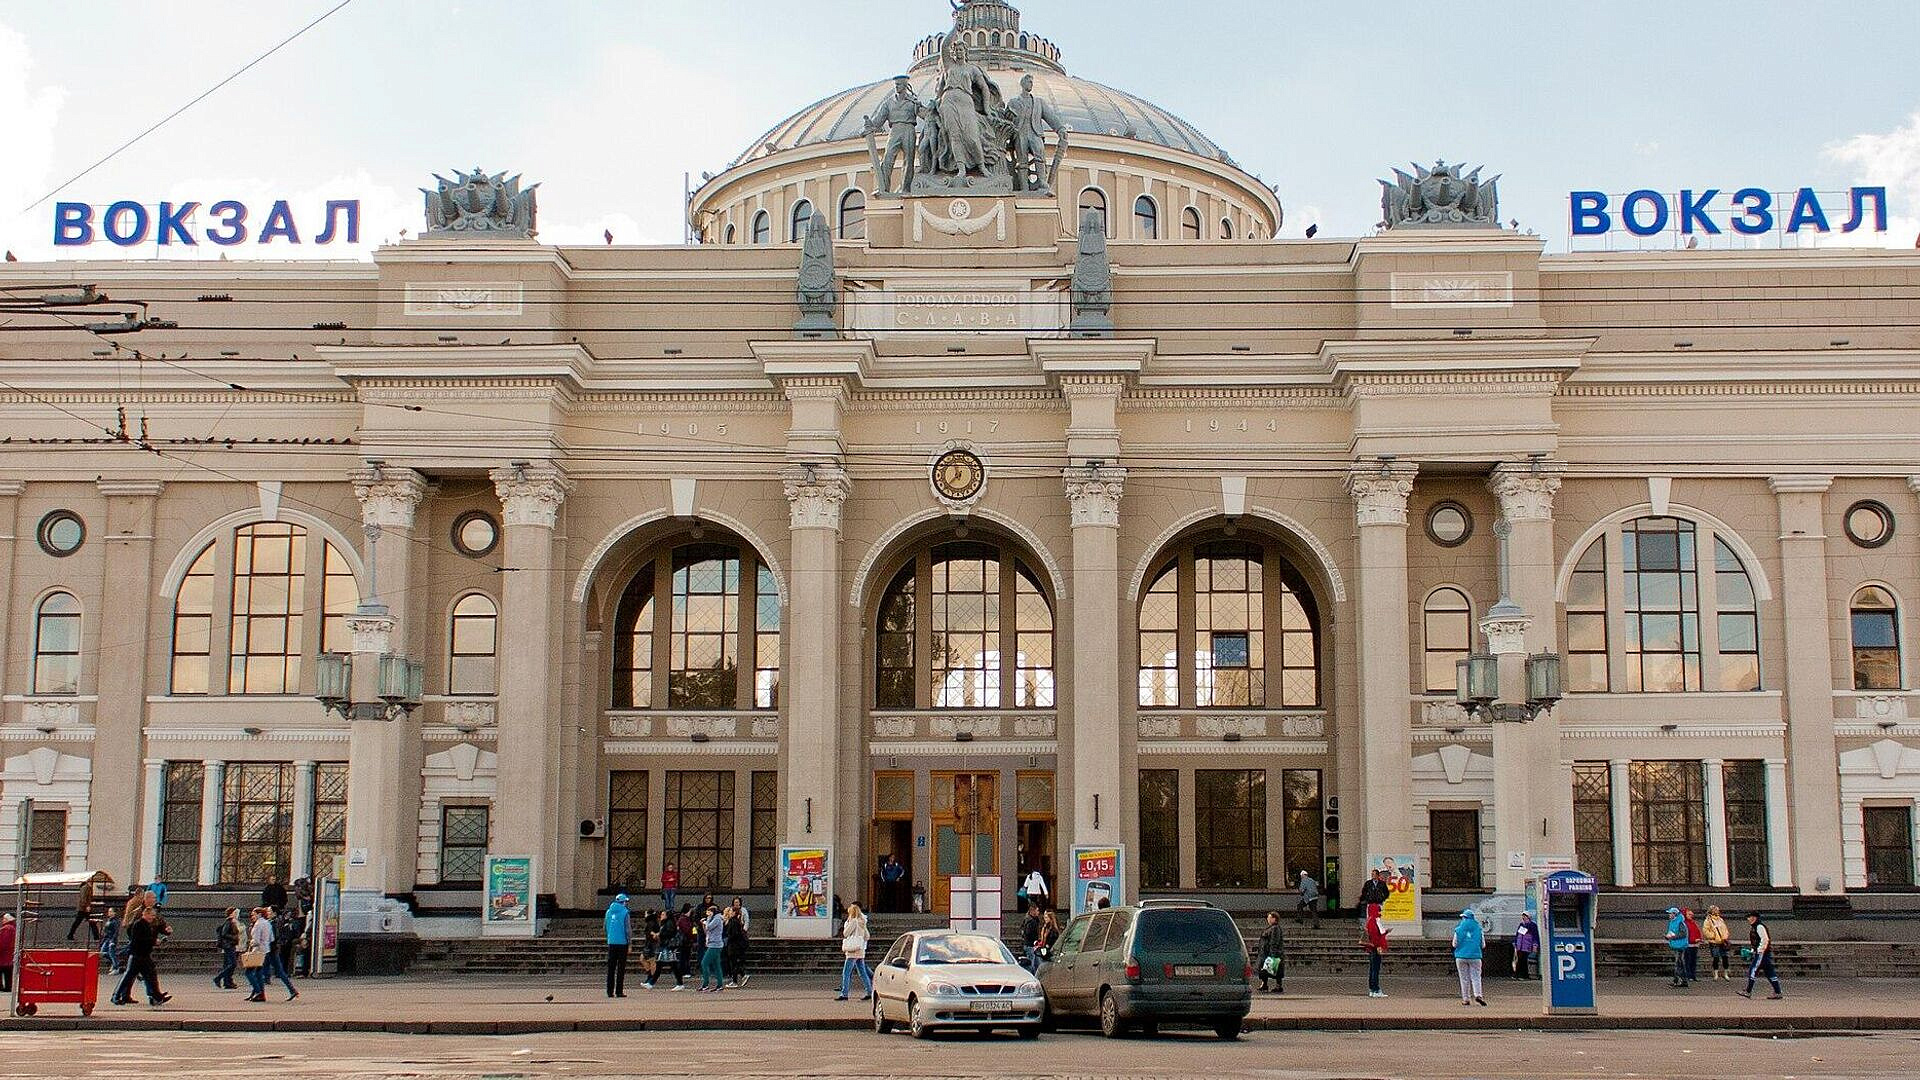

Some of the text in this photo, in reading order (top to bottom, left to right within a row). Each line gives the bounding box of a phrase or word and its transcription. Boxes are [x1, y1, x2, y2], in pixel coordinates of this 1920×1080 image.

[1570, 187, 1888, 236] ВОКЗАЛ
[54, 200, 360, 245] ВОКЗАЛ
[638, 422, 728, 435] 1905
[915, 419, 1000, 434] 1917
[1185, 418, 1278, 432] 1944
[1086, 859, 1109, 872] 0,15
[1558, 955, 1576, 981] P
